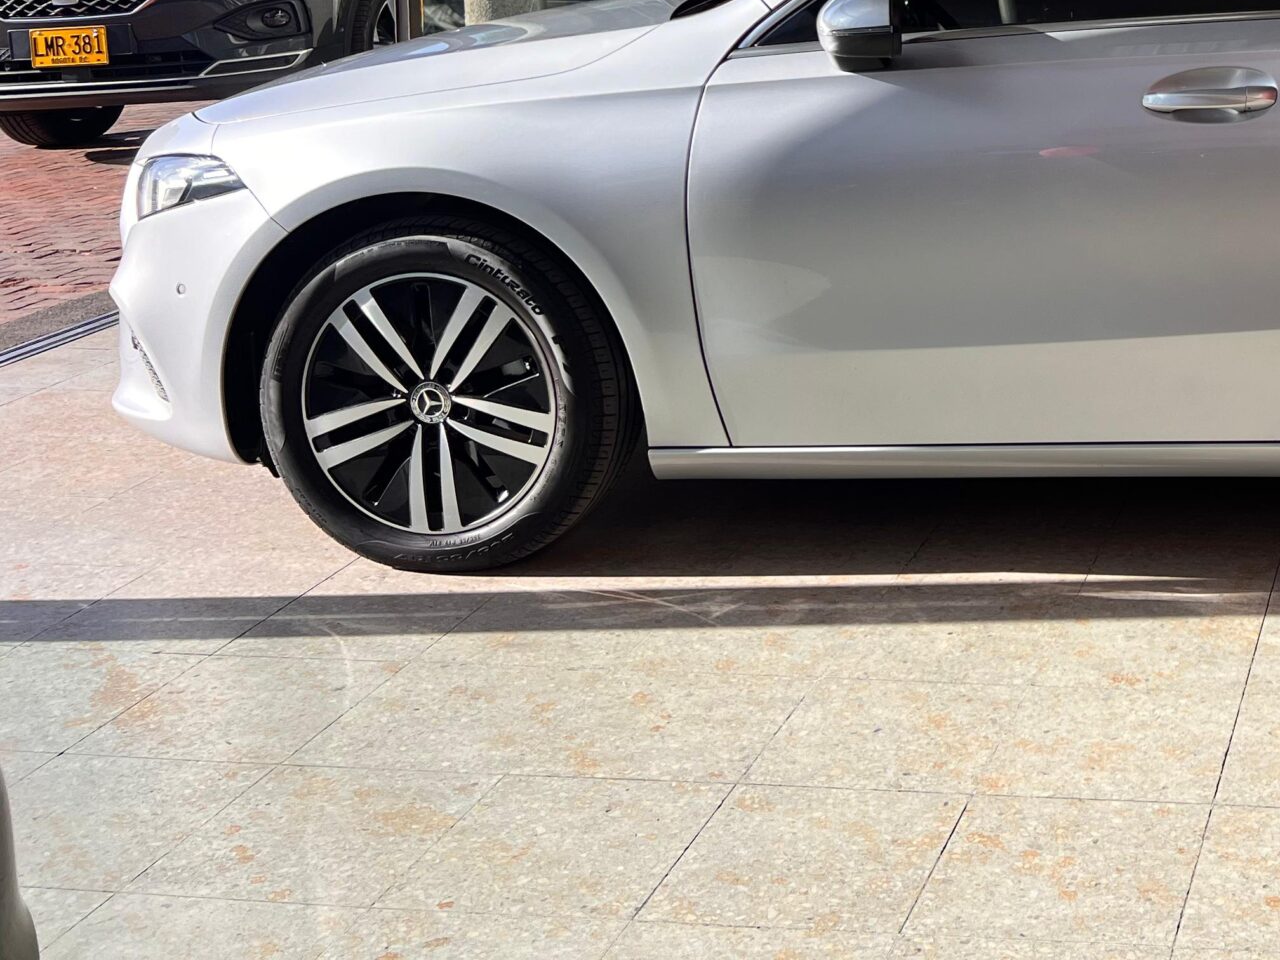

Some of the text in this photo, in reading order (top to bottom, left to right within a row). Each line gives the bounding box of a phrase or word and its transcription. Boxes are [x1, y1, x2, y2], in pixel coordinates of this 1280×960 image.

[33, 33, 104, 57] LMR 381
[464, 253, 544, 316] Cinturato
